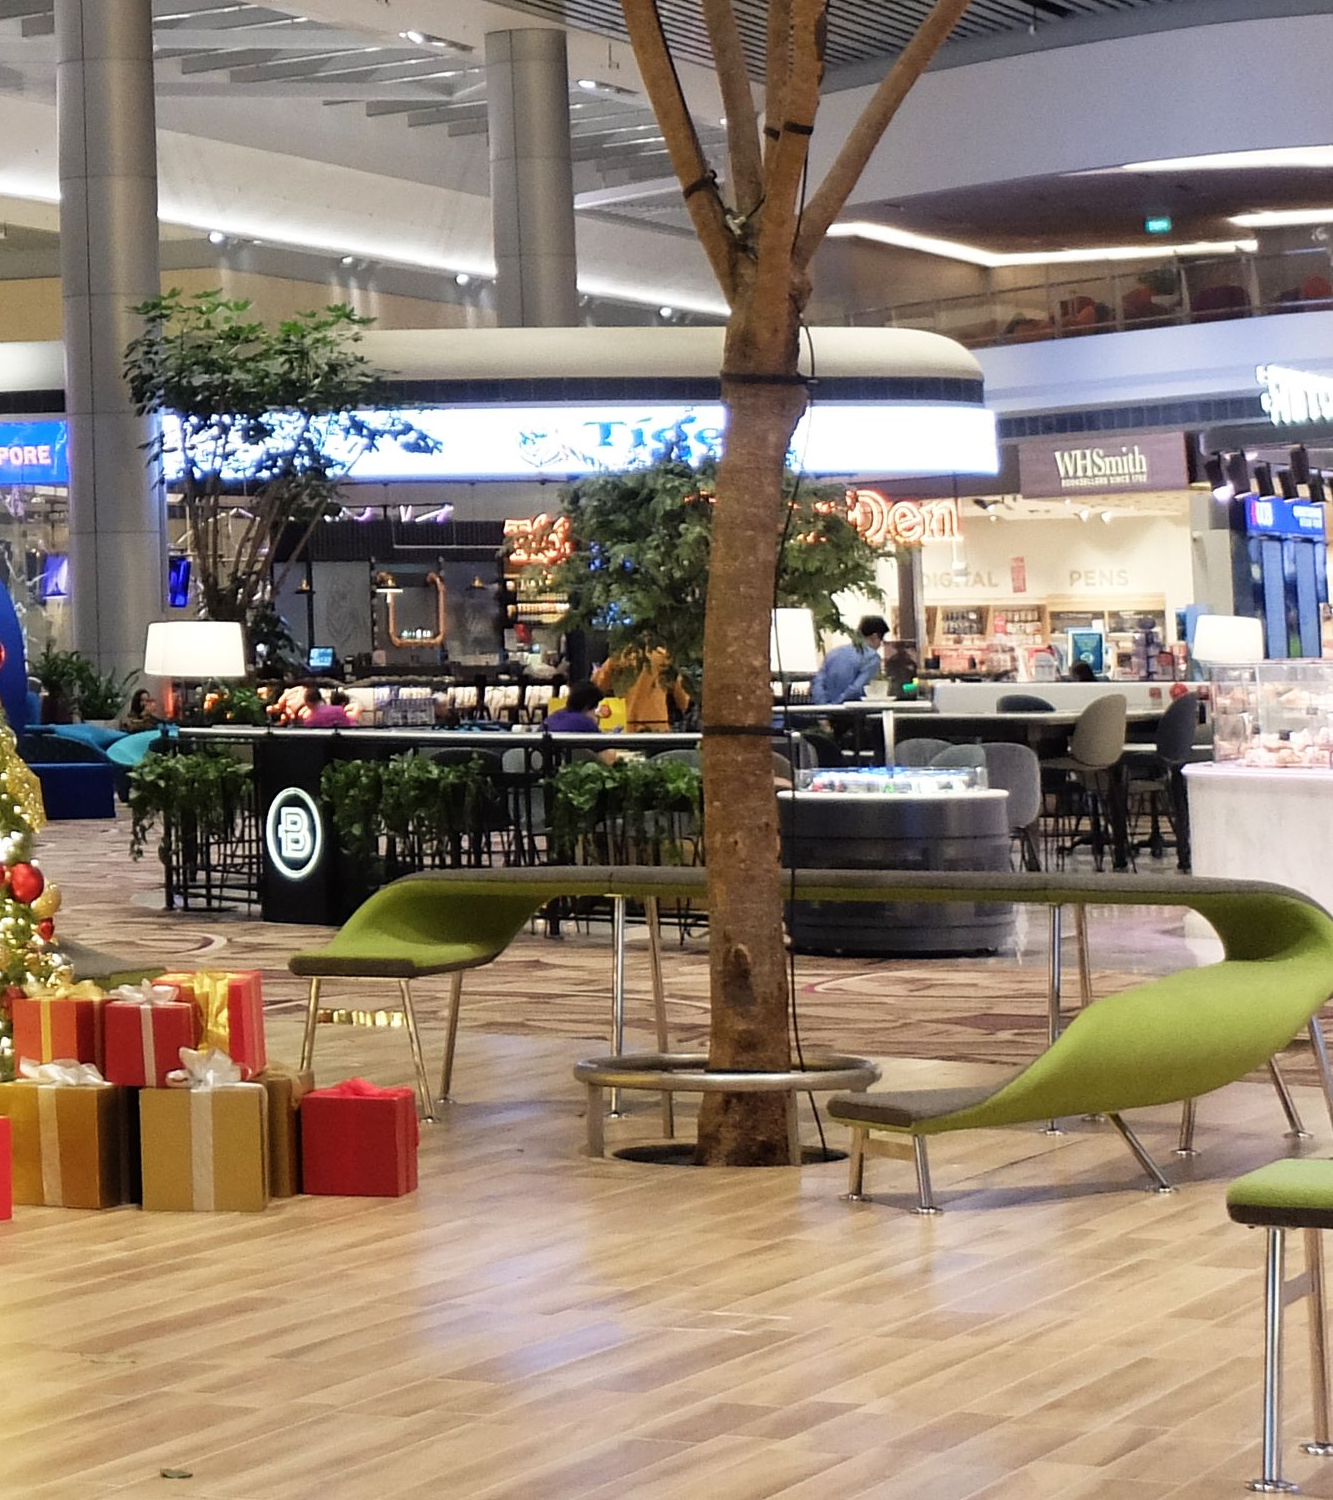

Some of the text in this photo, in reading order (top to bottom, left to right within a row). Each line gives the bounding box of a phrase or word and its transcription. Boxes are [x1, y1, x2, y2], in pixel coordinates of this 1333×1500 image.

[1054, 445, 1148, 478] WHSmith
[845, 489, 964, 546] Den
[923, 571, 999, 588] DIGTAL
[1069, 569, 1130, 587] PENS
